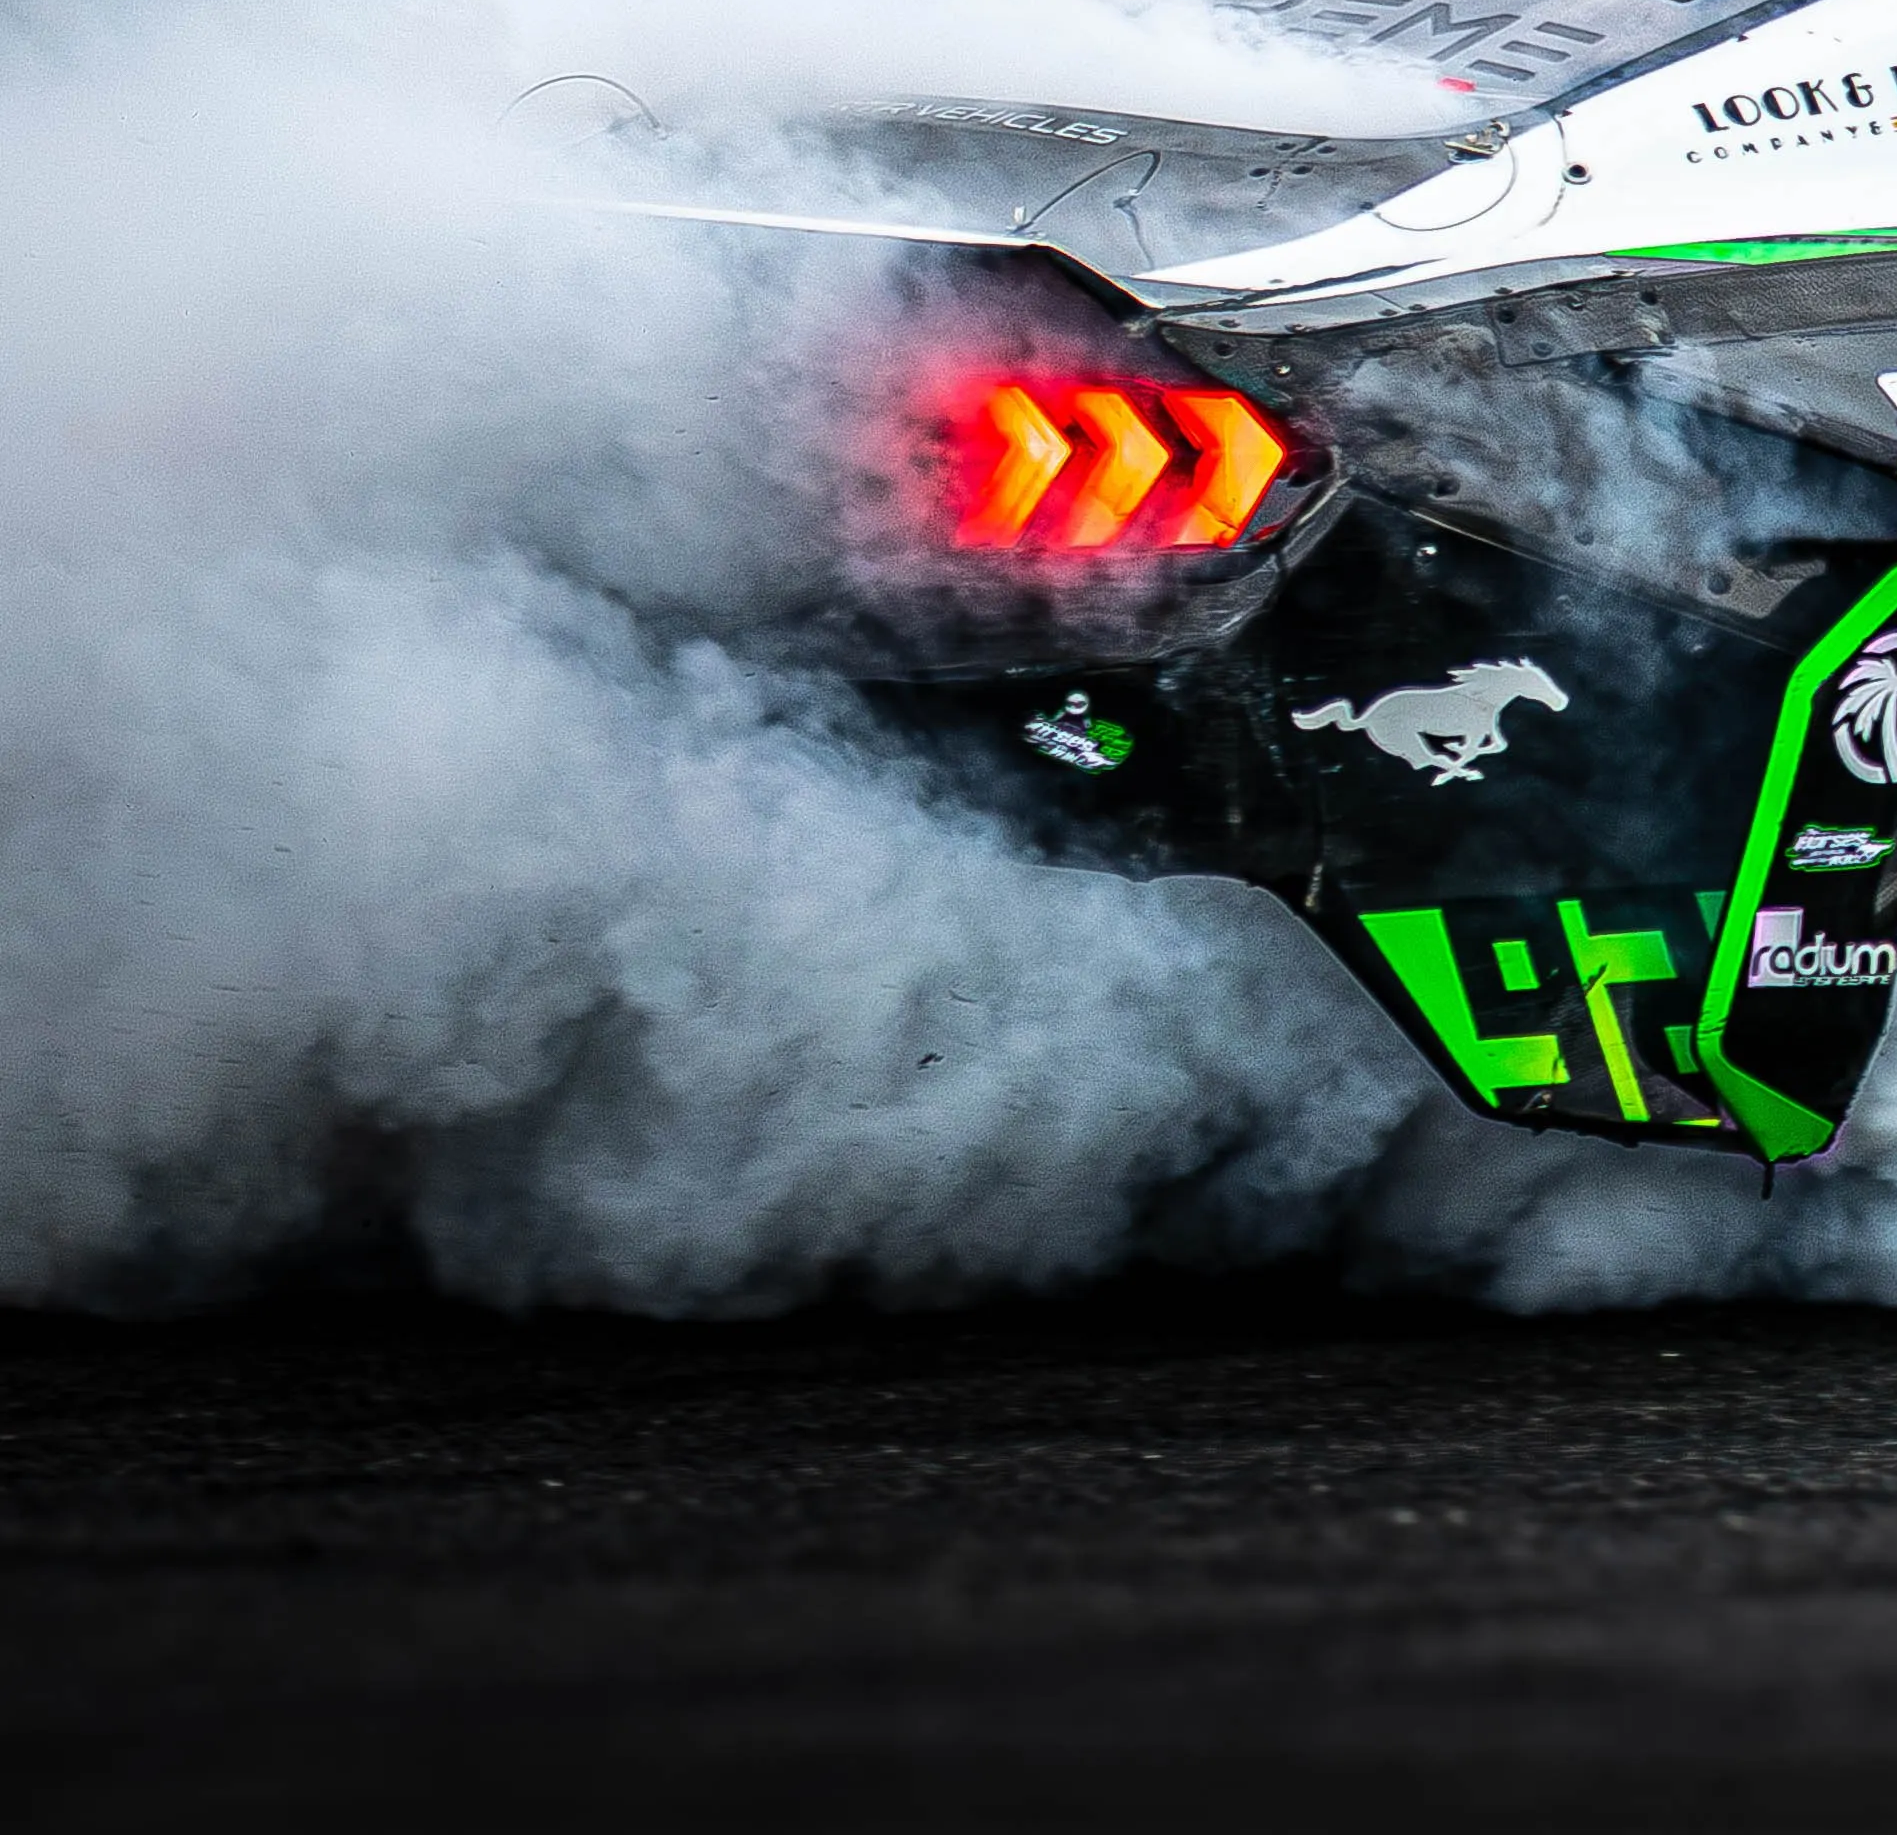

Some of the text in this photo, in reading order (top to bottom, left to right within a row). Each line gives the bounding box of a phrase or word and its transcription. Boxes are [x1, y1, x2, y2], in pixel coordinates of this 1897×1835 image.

[915, 103, 1129, 145] VEHICLES
[1691, 78, 1839, 133] LOOK
[1842, 71, 1876, 108] &
[1751, 931, 1897, 977] radium
